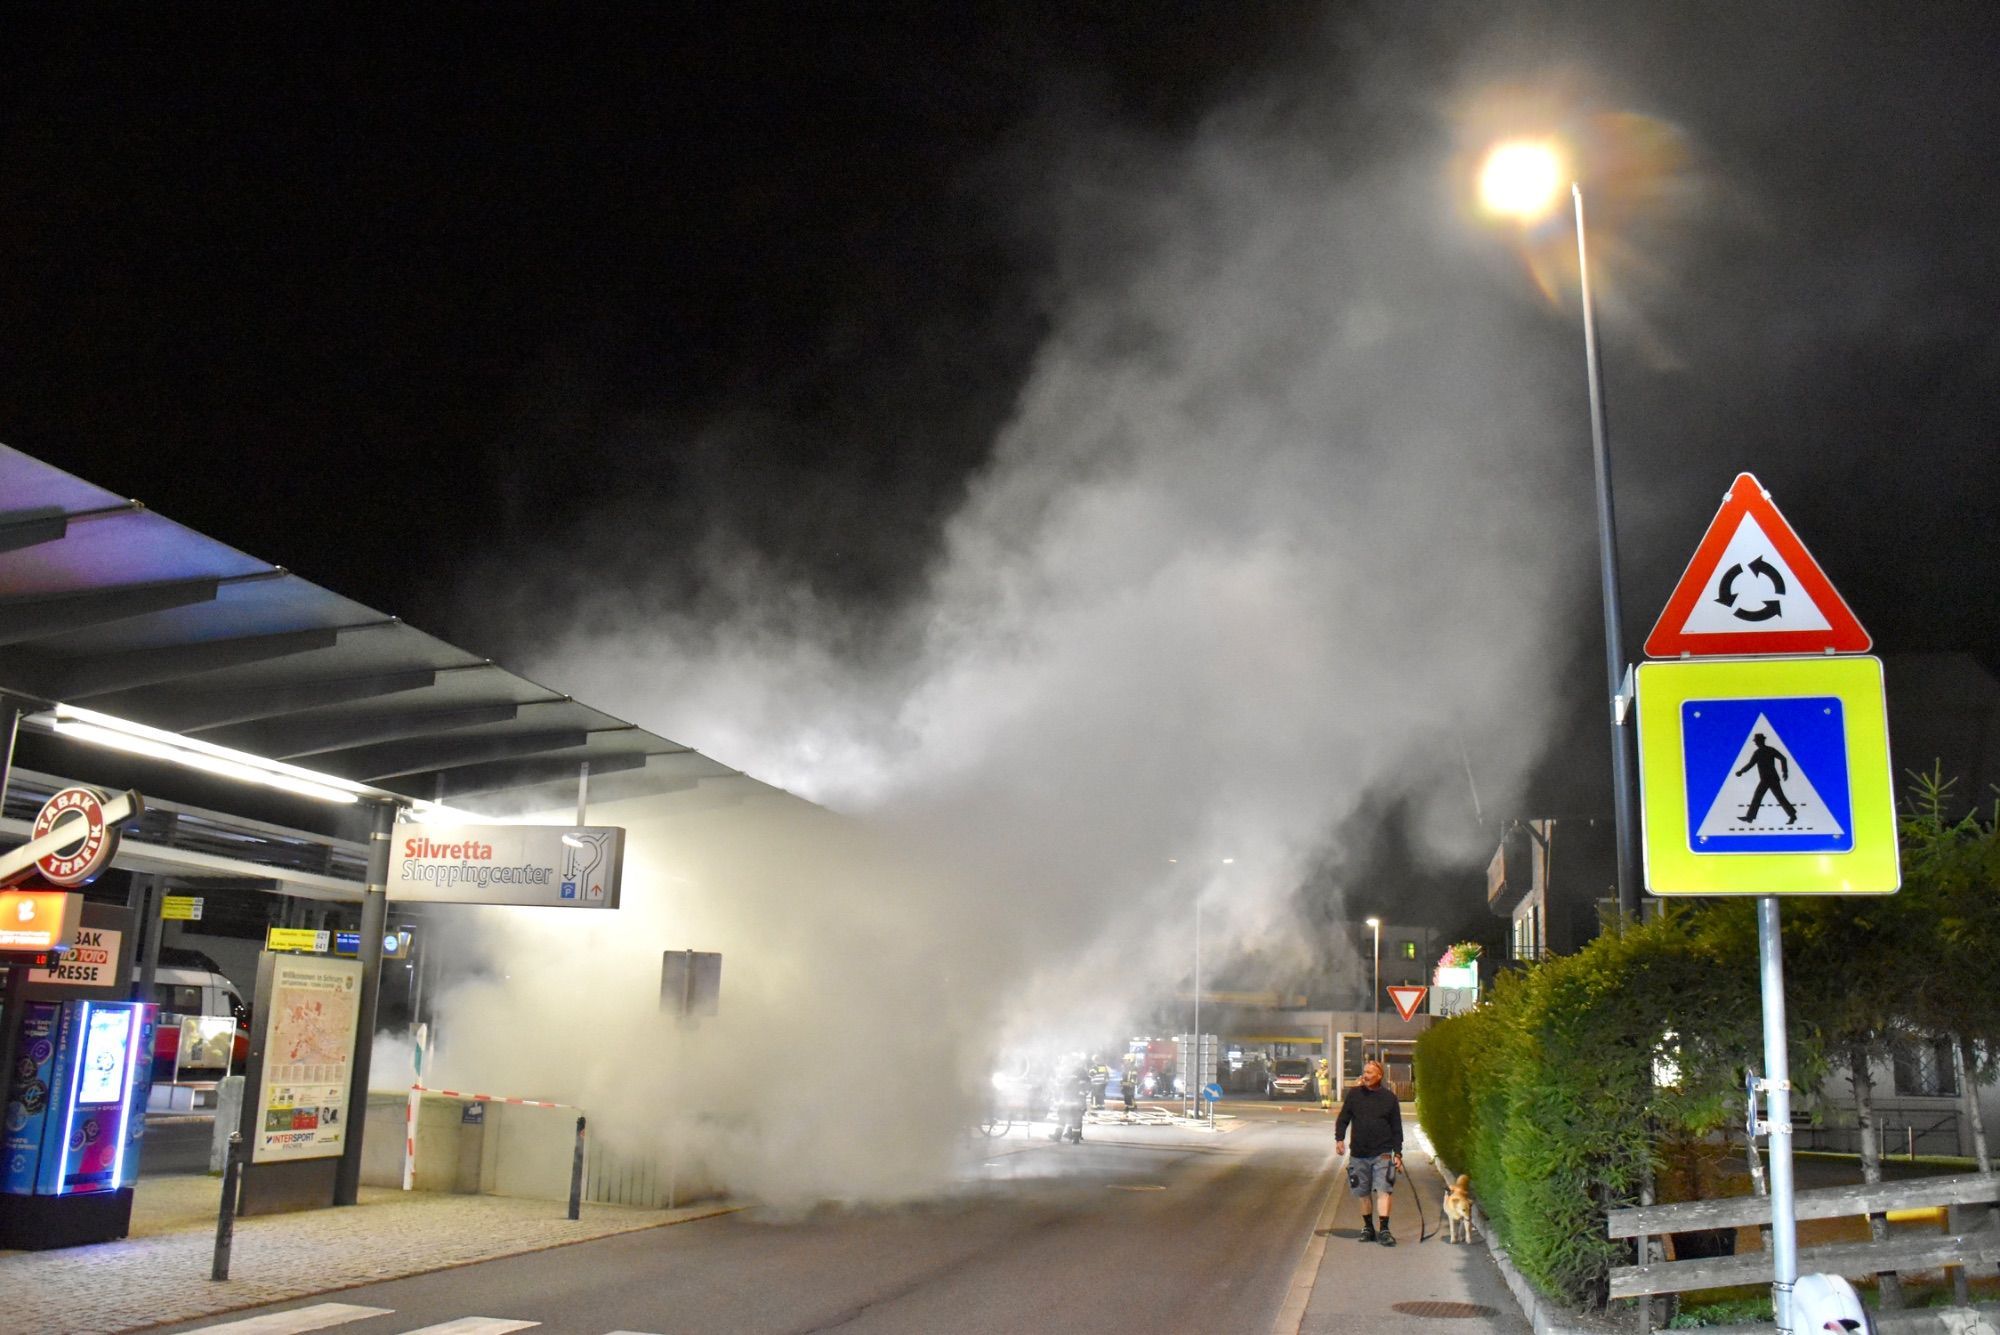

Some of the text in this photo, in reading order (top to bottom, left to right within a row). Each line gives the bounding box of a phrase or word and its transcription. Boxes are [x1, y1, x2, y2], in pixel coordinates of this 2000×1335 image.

[38, 793, 94, 831] TABAK
[49, 824, 102, 875] TRAFIK
[404, 838, 492, 860] Silvretta
[402, 859, 553, 888] Shoppingcenter
[74, 931, 102, 947] BAK
[79, 949, 107, 963] TOTO
[48, 965, 98, 981] PRESSE
[59, 1007, 71, 1051] SPIRIT
[272, 1132, 315, 1144] INTERSPORT
